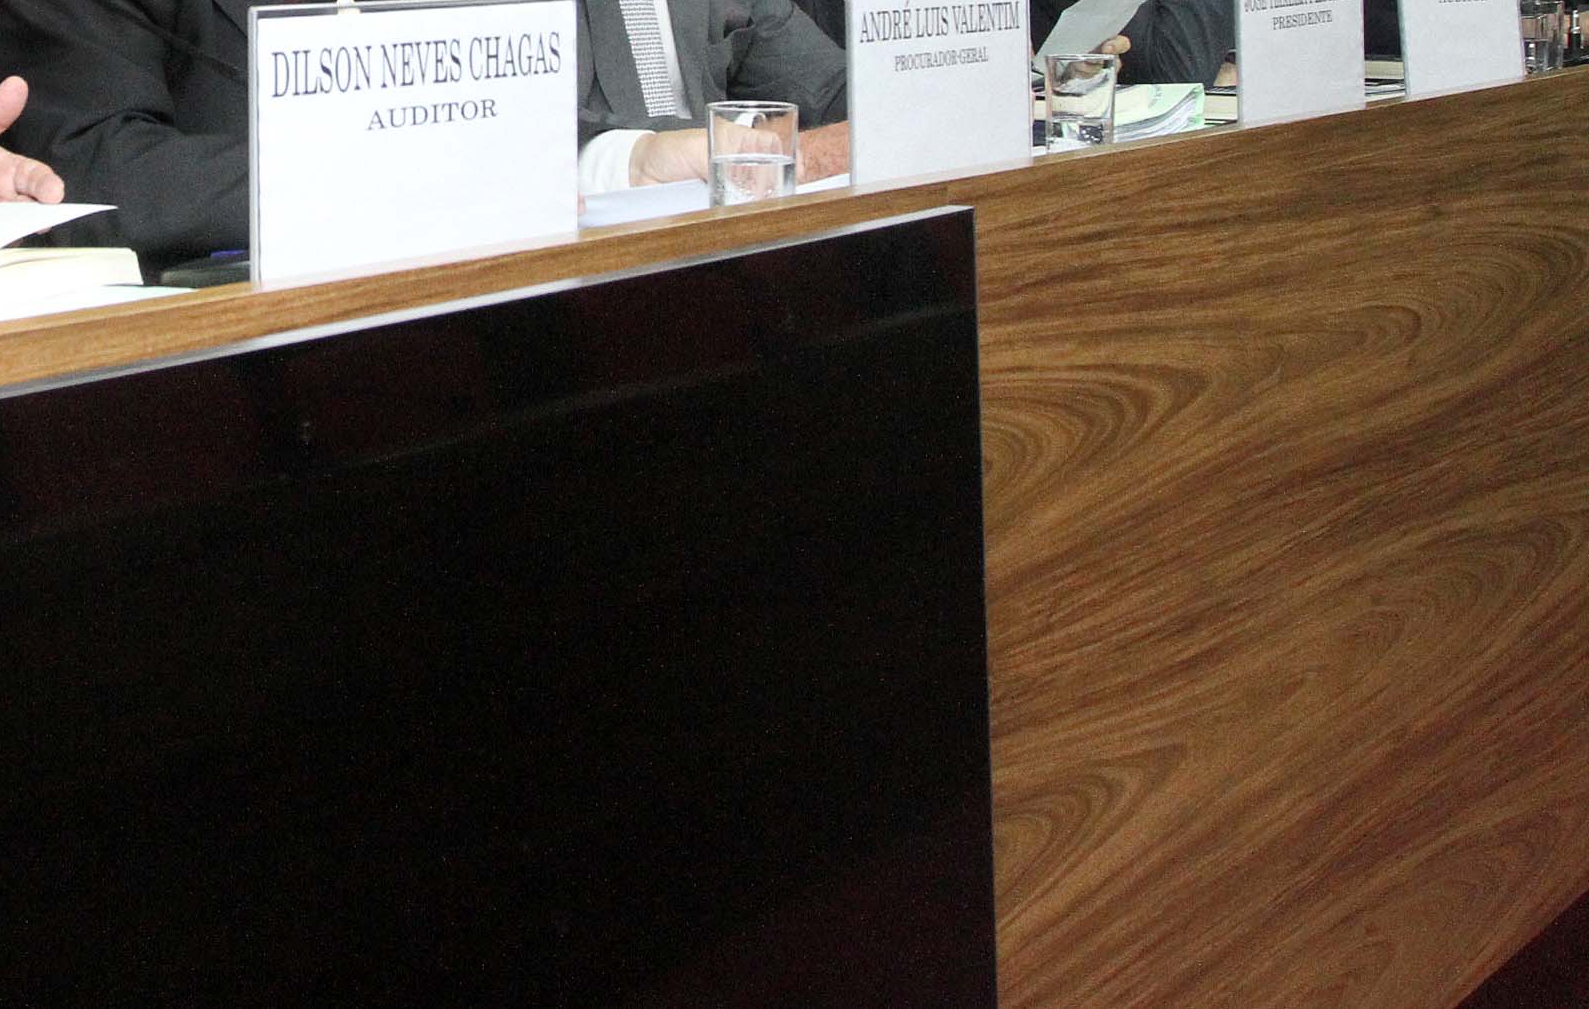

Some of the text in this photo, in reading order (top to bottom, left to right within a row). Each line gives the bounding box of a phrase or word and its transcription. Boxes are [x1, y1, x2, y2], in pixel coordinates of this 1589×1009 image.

[860, 0, 1020, 43] ANDRÉ LUIS VALENTIM
[1272, 9, 1332, 30] PRESIDENTE
[271, 31, 561, 98] DILSON NEVES CHAGAS
[365, 99, 497, 131] AUDITOR
